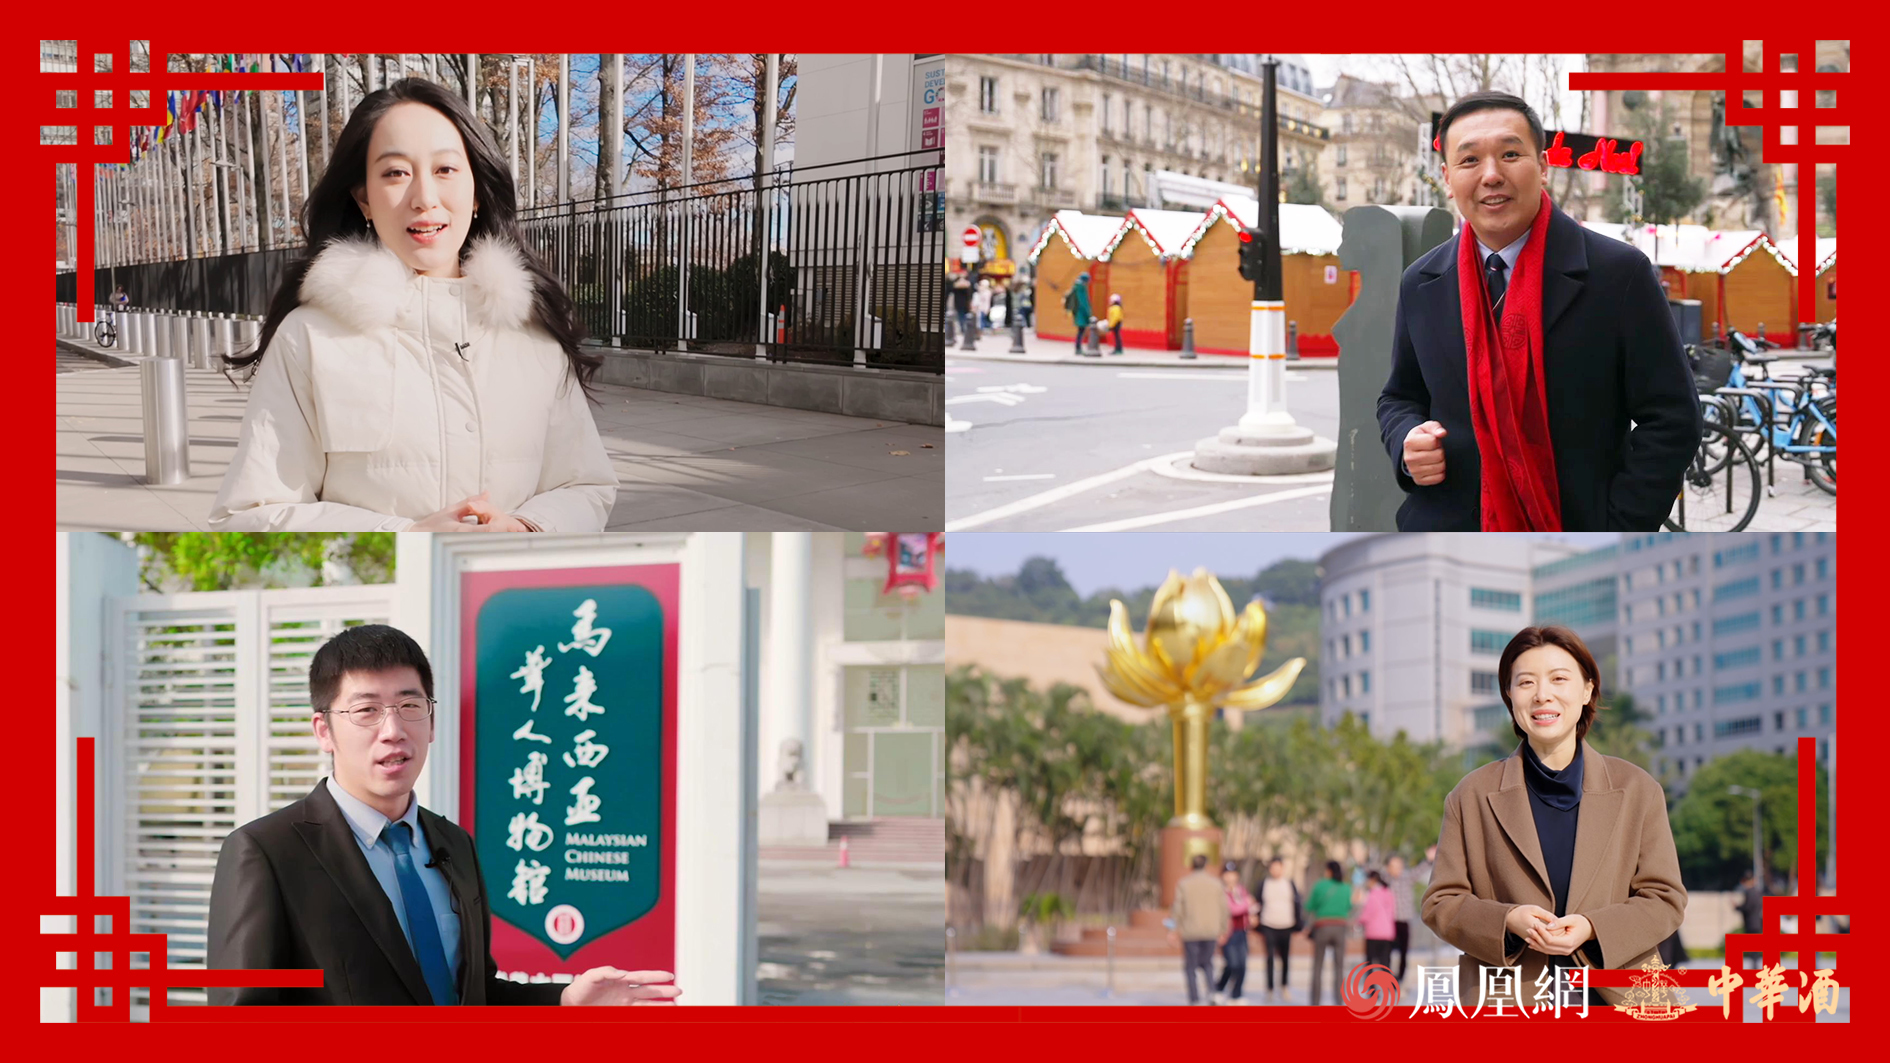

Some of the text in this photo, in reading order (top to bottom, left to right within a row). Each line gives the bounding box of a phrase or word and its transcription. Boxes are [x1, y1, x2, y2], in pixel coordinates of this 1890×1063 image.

[564, 832, 648, 847] MALAYSIAN
[564, 849, 630, 864] CHINESE
[564, 867, 630, 882] MUSEUM
